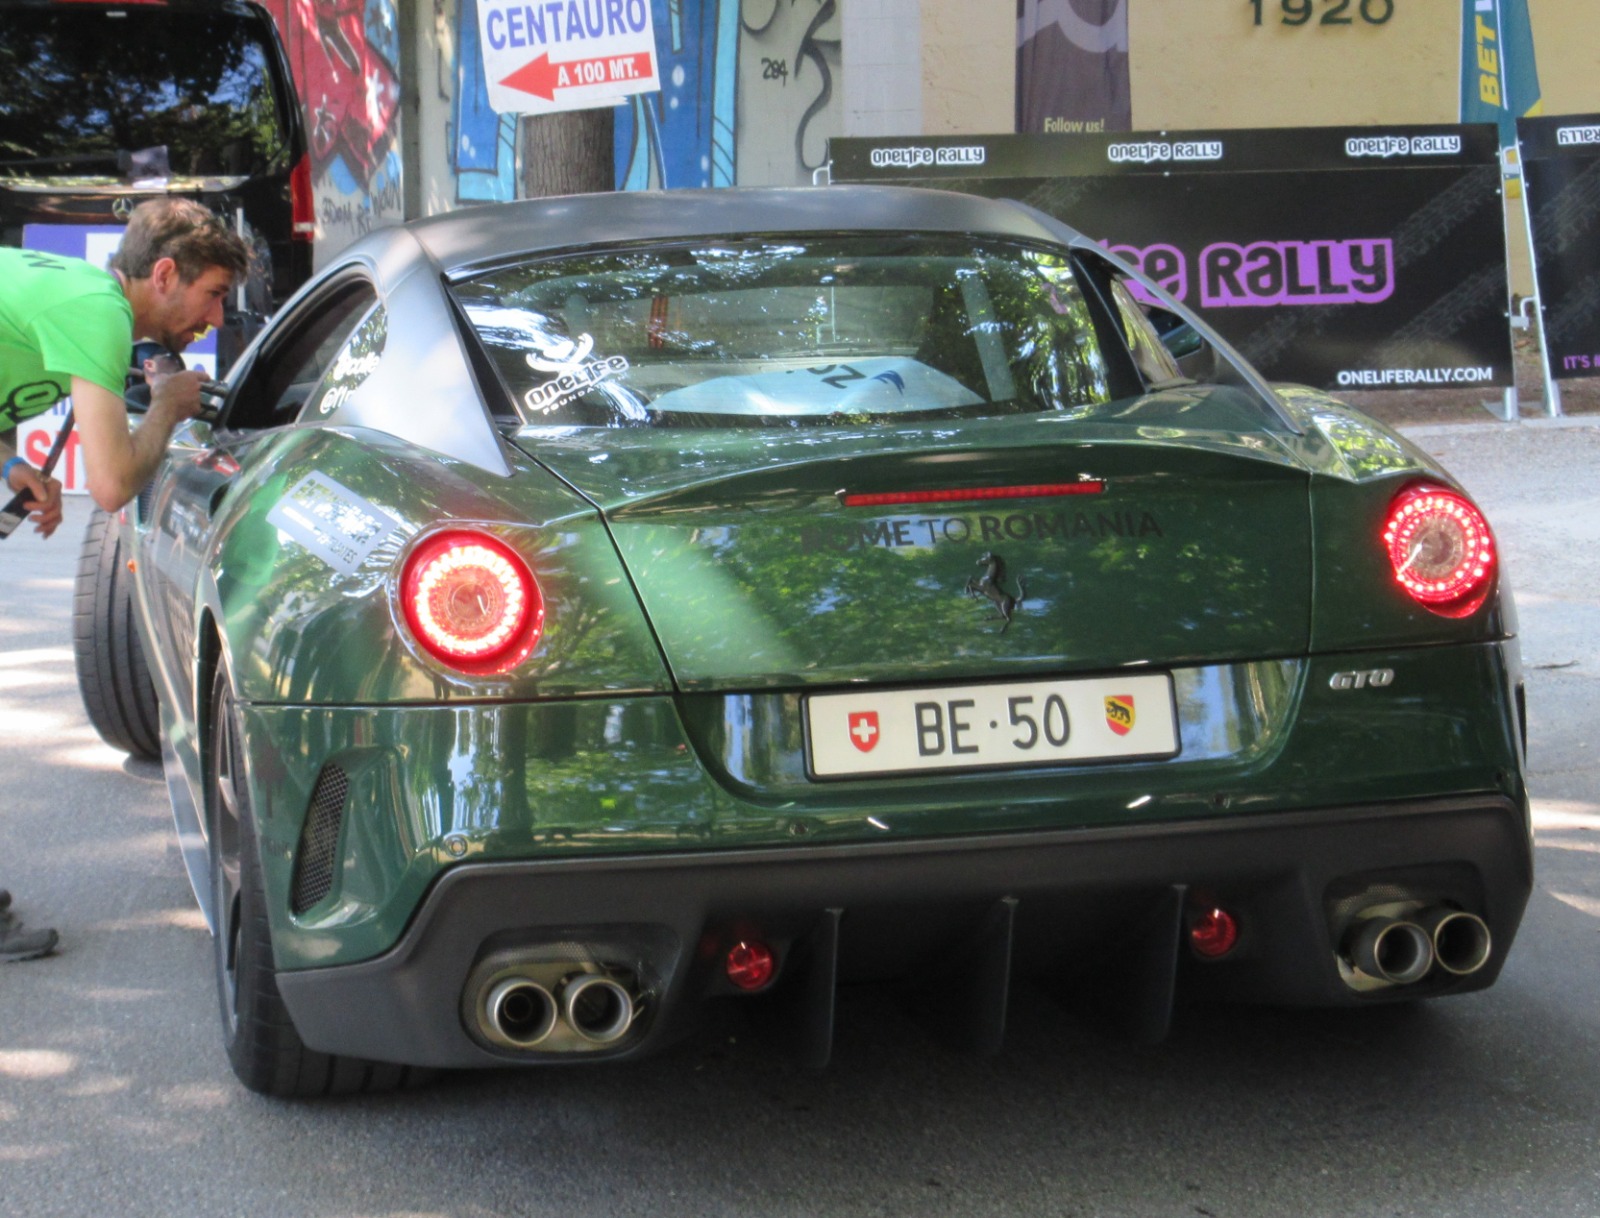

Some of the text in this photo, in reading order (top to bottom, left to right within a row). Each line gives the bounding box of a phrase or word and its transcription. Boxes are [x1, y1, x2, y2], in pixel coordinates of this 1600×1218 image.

[487, 0, 647, 50] CENTAURO
[1250, 0, 1394, 26] 1920
[557, 57, 639, 87] A 100 MT.
[1044, 117, 1105, 133] Follow us!
[1563, 354, 1590, 369] IT'S
[1337, 367, 1493, 385] ONELIFERALLY.COM
[921, 517, 970, 544] TO
[978, 510, 1165, 543] ROMANIA
[1329, 668, 1394, 690] GTO
